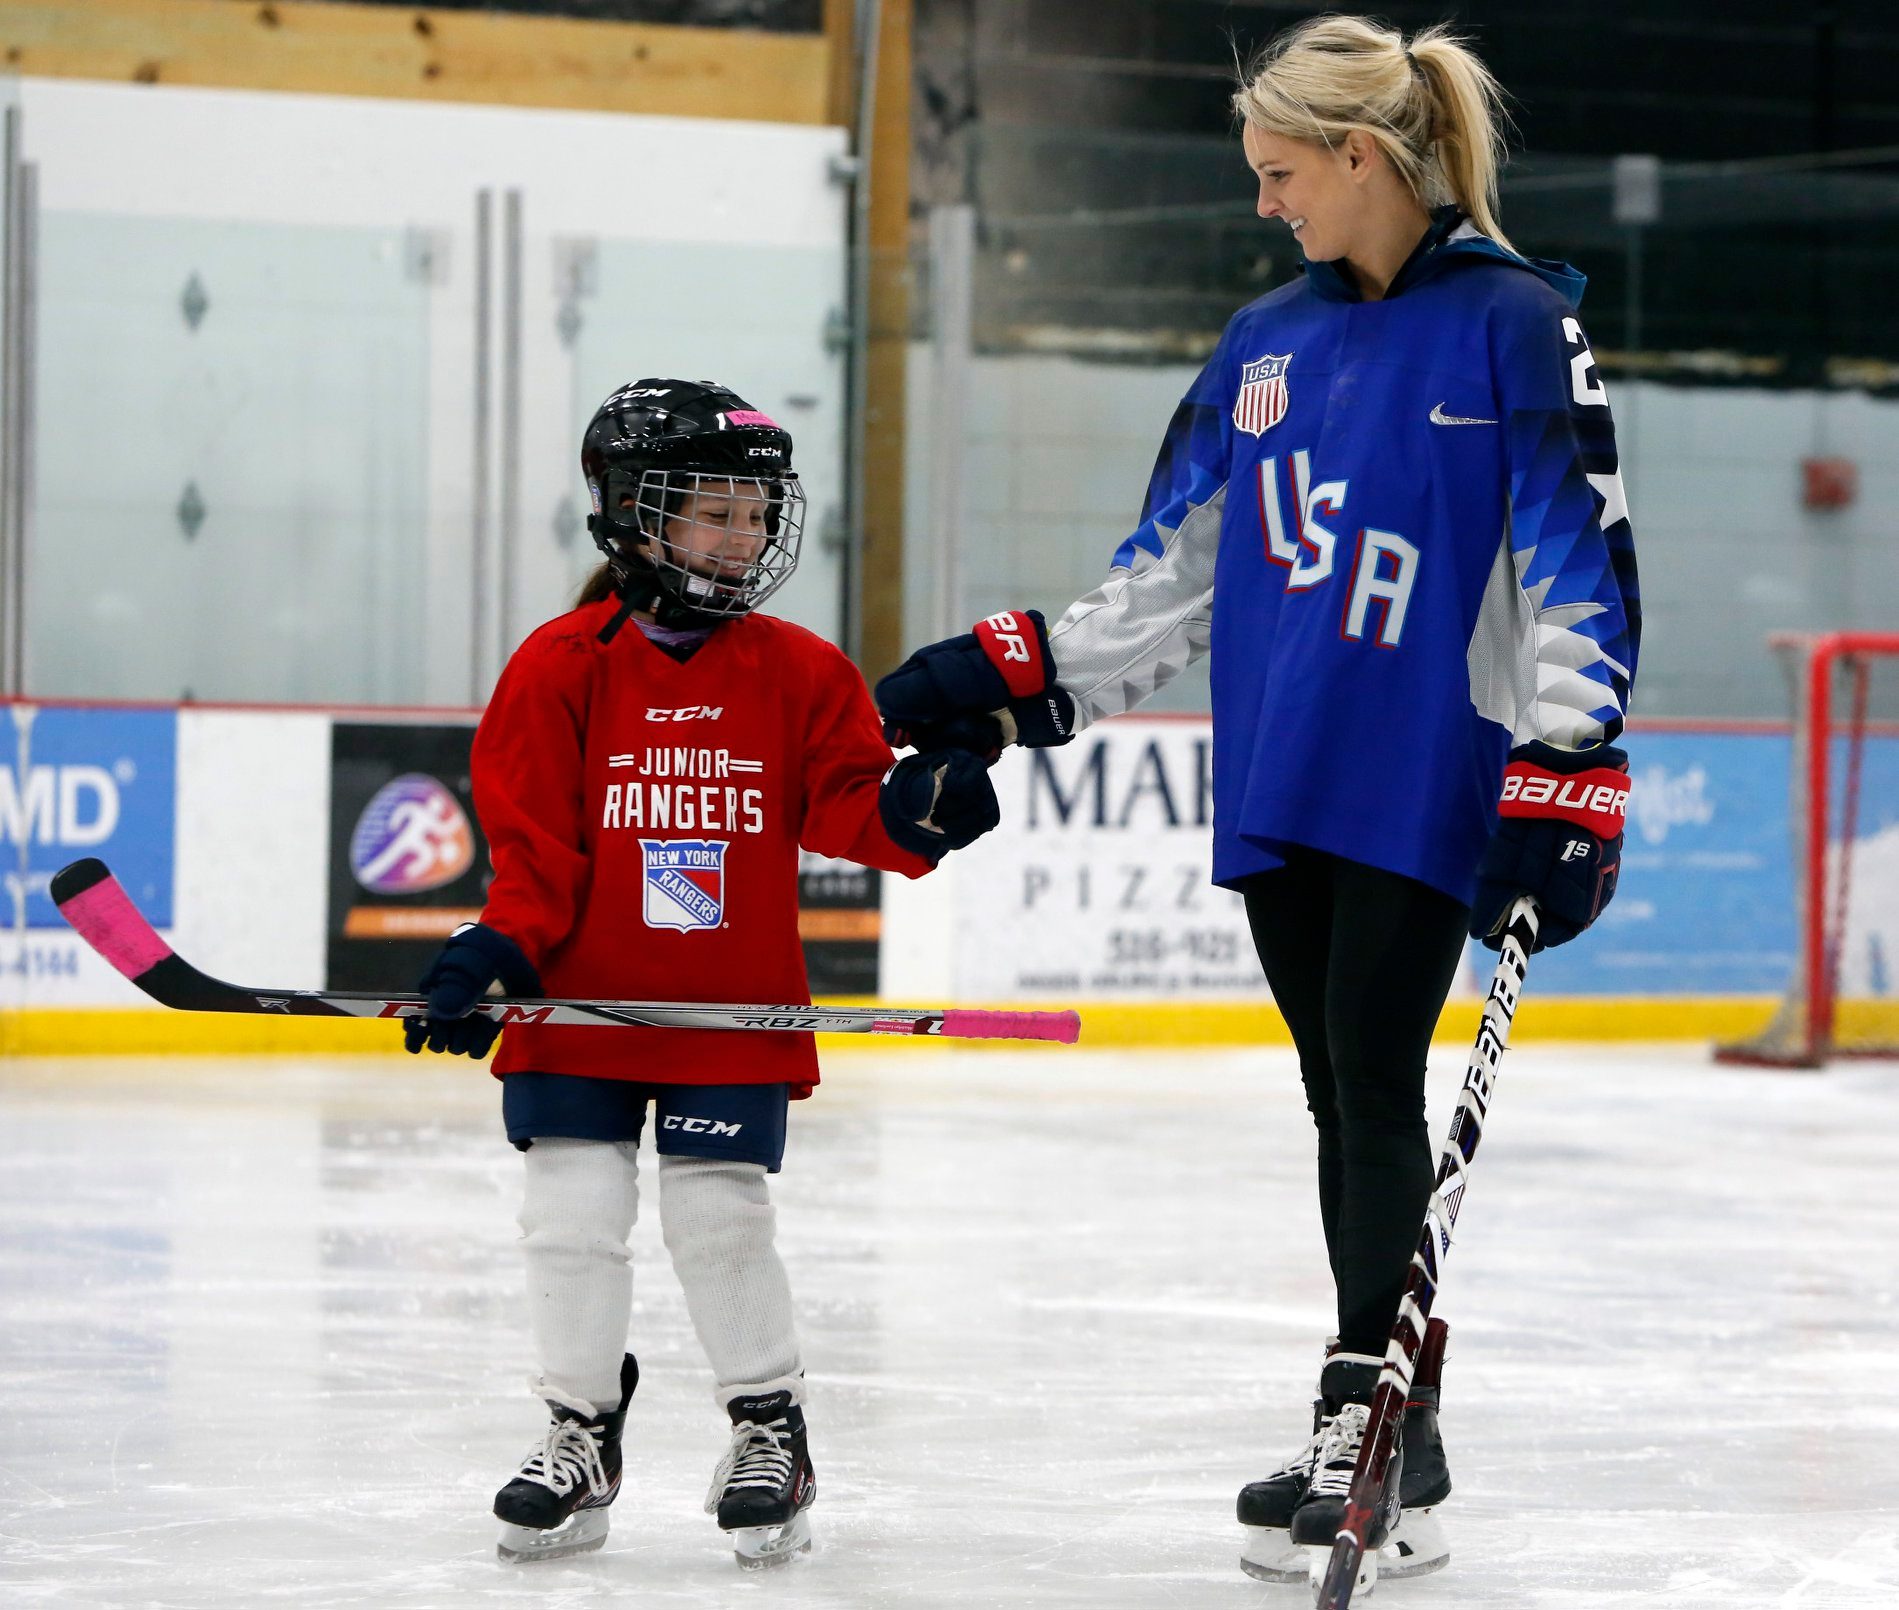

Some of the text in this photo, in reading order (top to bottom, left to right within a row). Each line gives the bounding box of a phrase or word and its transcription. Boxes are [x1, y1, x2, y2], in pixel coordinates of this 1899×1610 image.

[1248, 364, 1280, 383] USA
[603, 387, 671, 407] CCM
[749, 447, 782, 458] CCM
[1257, 447, 1421, 651] USA
[644, 705, 723, 722] CCM
[638, 747, 730, 778] JUNIOR
[602, 782, 764, 834] RANGERS
[648, 850, 720, 866] NEW YORK
[658, 869, 719, 923] RANGERS
[1022, 863, 1244, 910] PIZZ
[732, 1016, 819, 1031] RBZ
[662, 1115, 743, 1137] CCM
[743, 1397, 780, 1408] CCM
